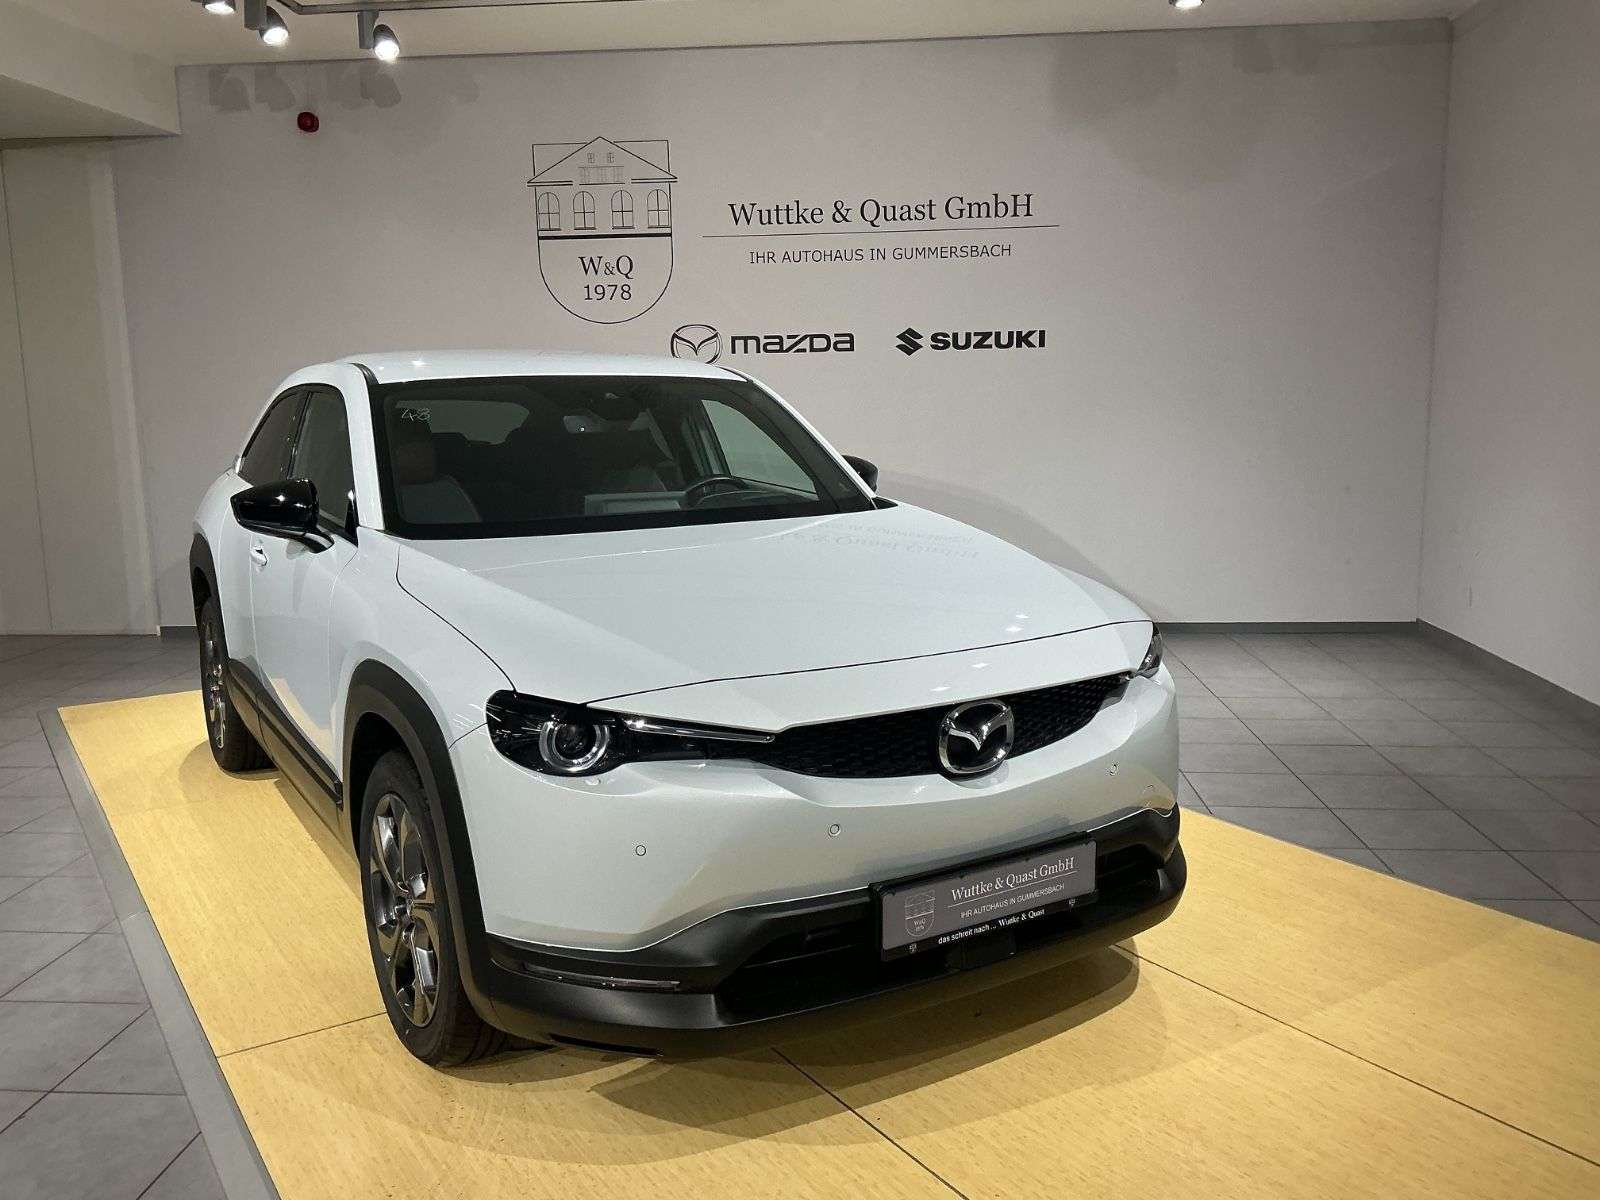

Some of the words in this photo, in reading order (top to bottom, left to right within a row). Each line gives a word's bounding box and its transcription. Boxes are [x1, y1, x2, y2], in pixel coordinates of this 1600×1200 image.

[727, 199, 824, 227] Wuttke
[831, 199, 853, 224] &
[859, 199, 937, 228] Quast
[944, 192, 1035, 220] GmbH
[577, 254, 634, 280] W&Q
[749, 250, 777, 264] IHR
[781, 248, 865, 264] AUTOHAUS
[869, 247, 886, 261] IN
[892, 243, 1012, 261] GUMMERSBACH
[583, 283, 632, 301] 1978
[929, 329, 1046, 351] SUZUKI
[951, 880, 993, 901] Wuttke
[994, 877, 1005, 890] &
[1006, 868, 1038, 888] Quast
[1039, 857, 1075, 877] GmbH
[960, 909, 973, 919] IHR
[973, 899, 1009, 916] AUTOHAUS
[1009, 897, 1017, 905] IN
[1016, 883, 1065, 903] GUMMERSBACH
[938, 935, 950, 944] das
[973, 924, 990, 935] nach
[1028, 908, 1045, 919] Quast
